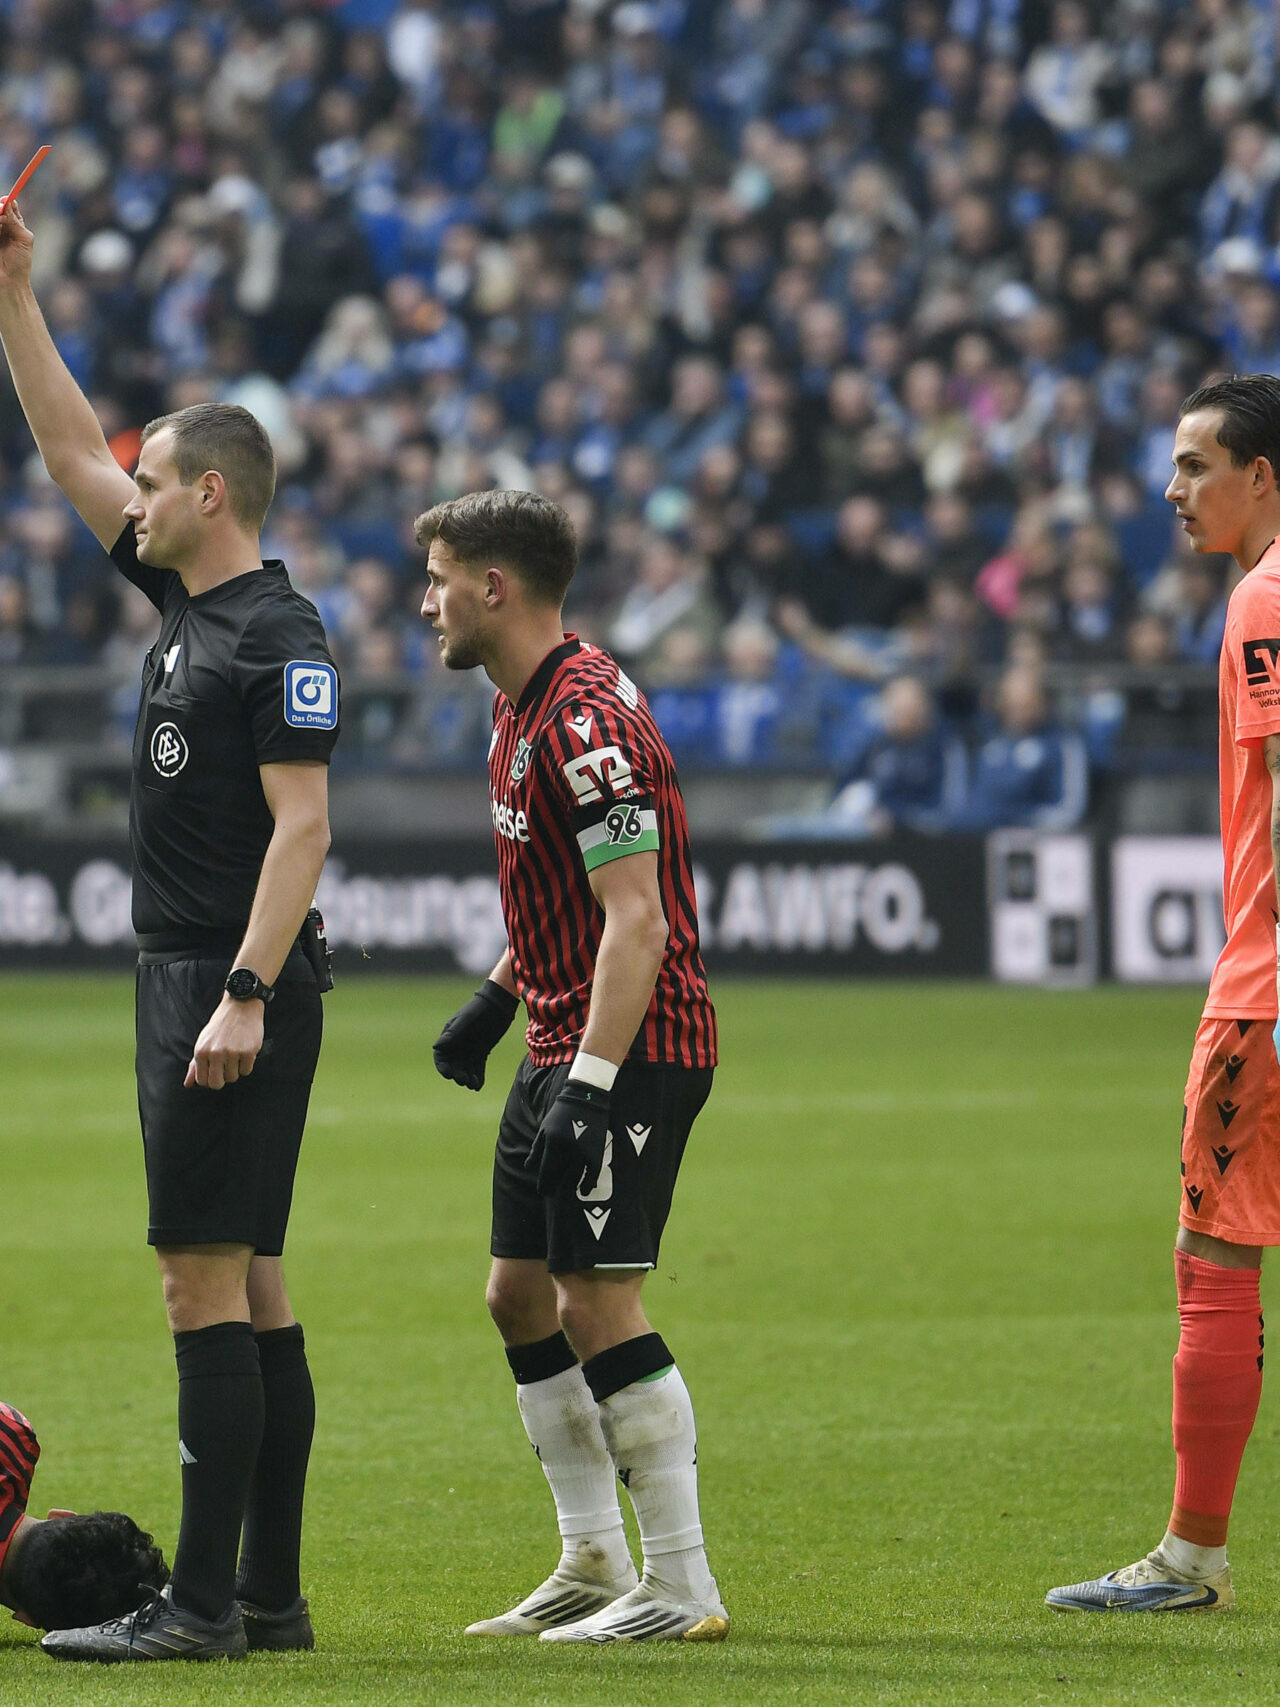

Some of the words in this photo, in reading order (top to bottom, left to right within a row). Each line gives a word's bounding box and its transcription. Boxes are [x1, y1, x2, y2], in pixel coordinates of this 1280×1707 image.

[291, 714, 305, 722] Das
[306, 713, 332, 725] Örtliche
[605, 805, 641, 845] 96
